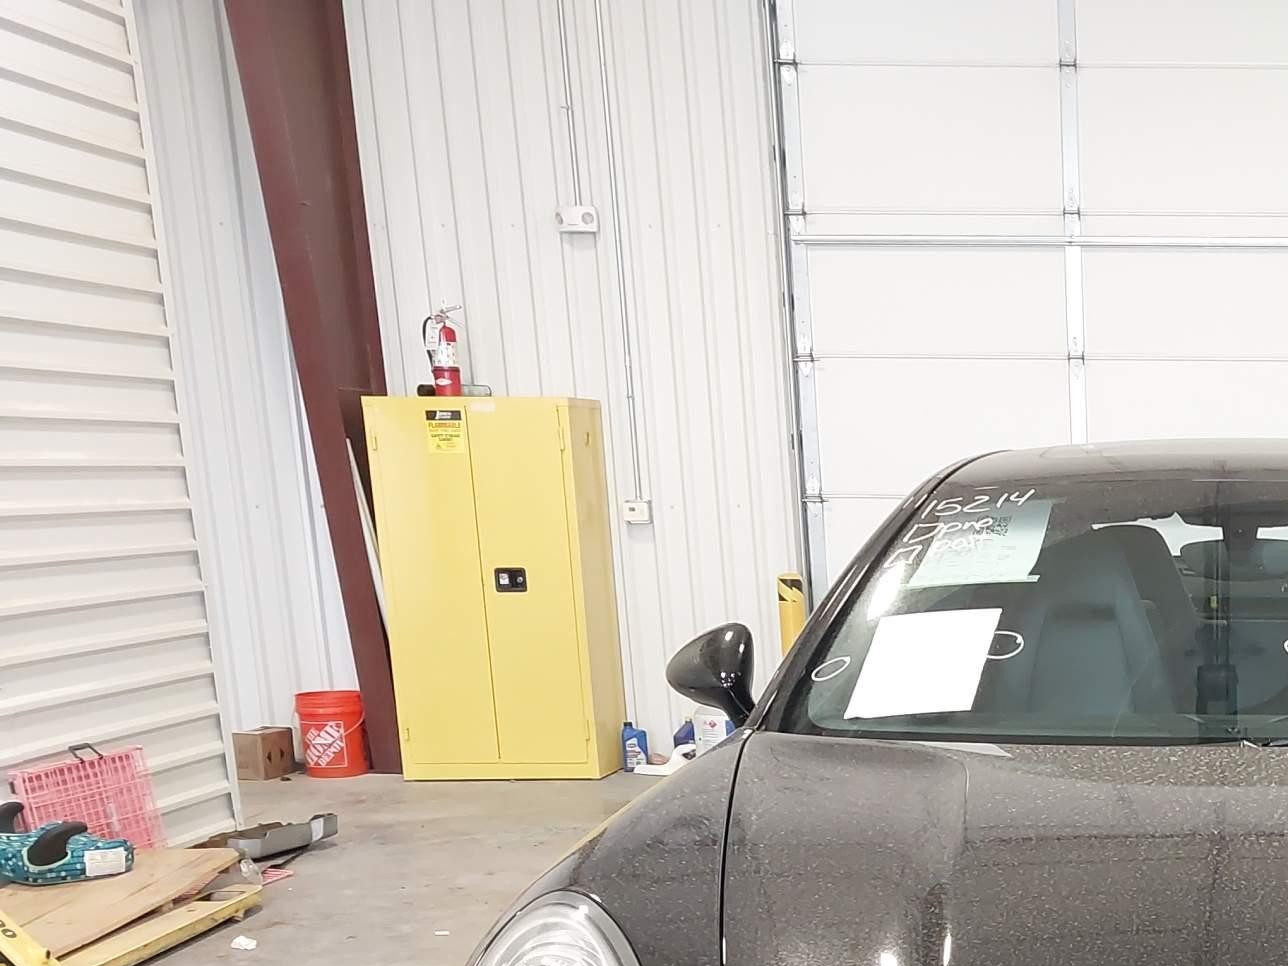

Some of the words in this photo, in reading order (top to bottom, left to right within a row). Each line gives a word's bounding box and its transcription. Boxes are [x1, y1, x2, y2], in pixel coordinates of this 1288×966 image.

[921, 488, 1035, 519] 15214
[305, 721, 343, 766] HOME
[318, 740, 345, 767] DEPOT
